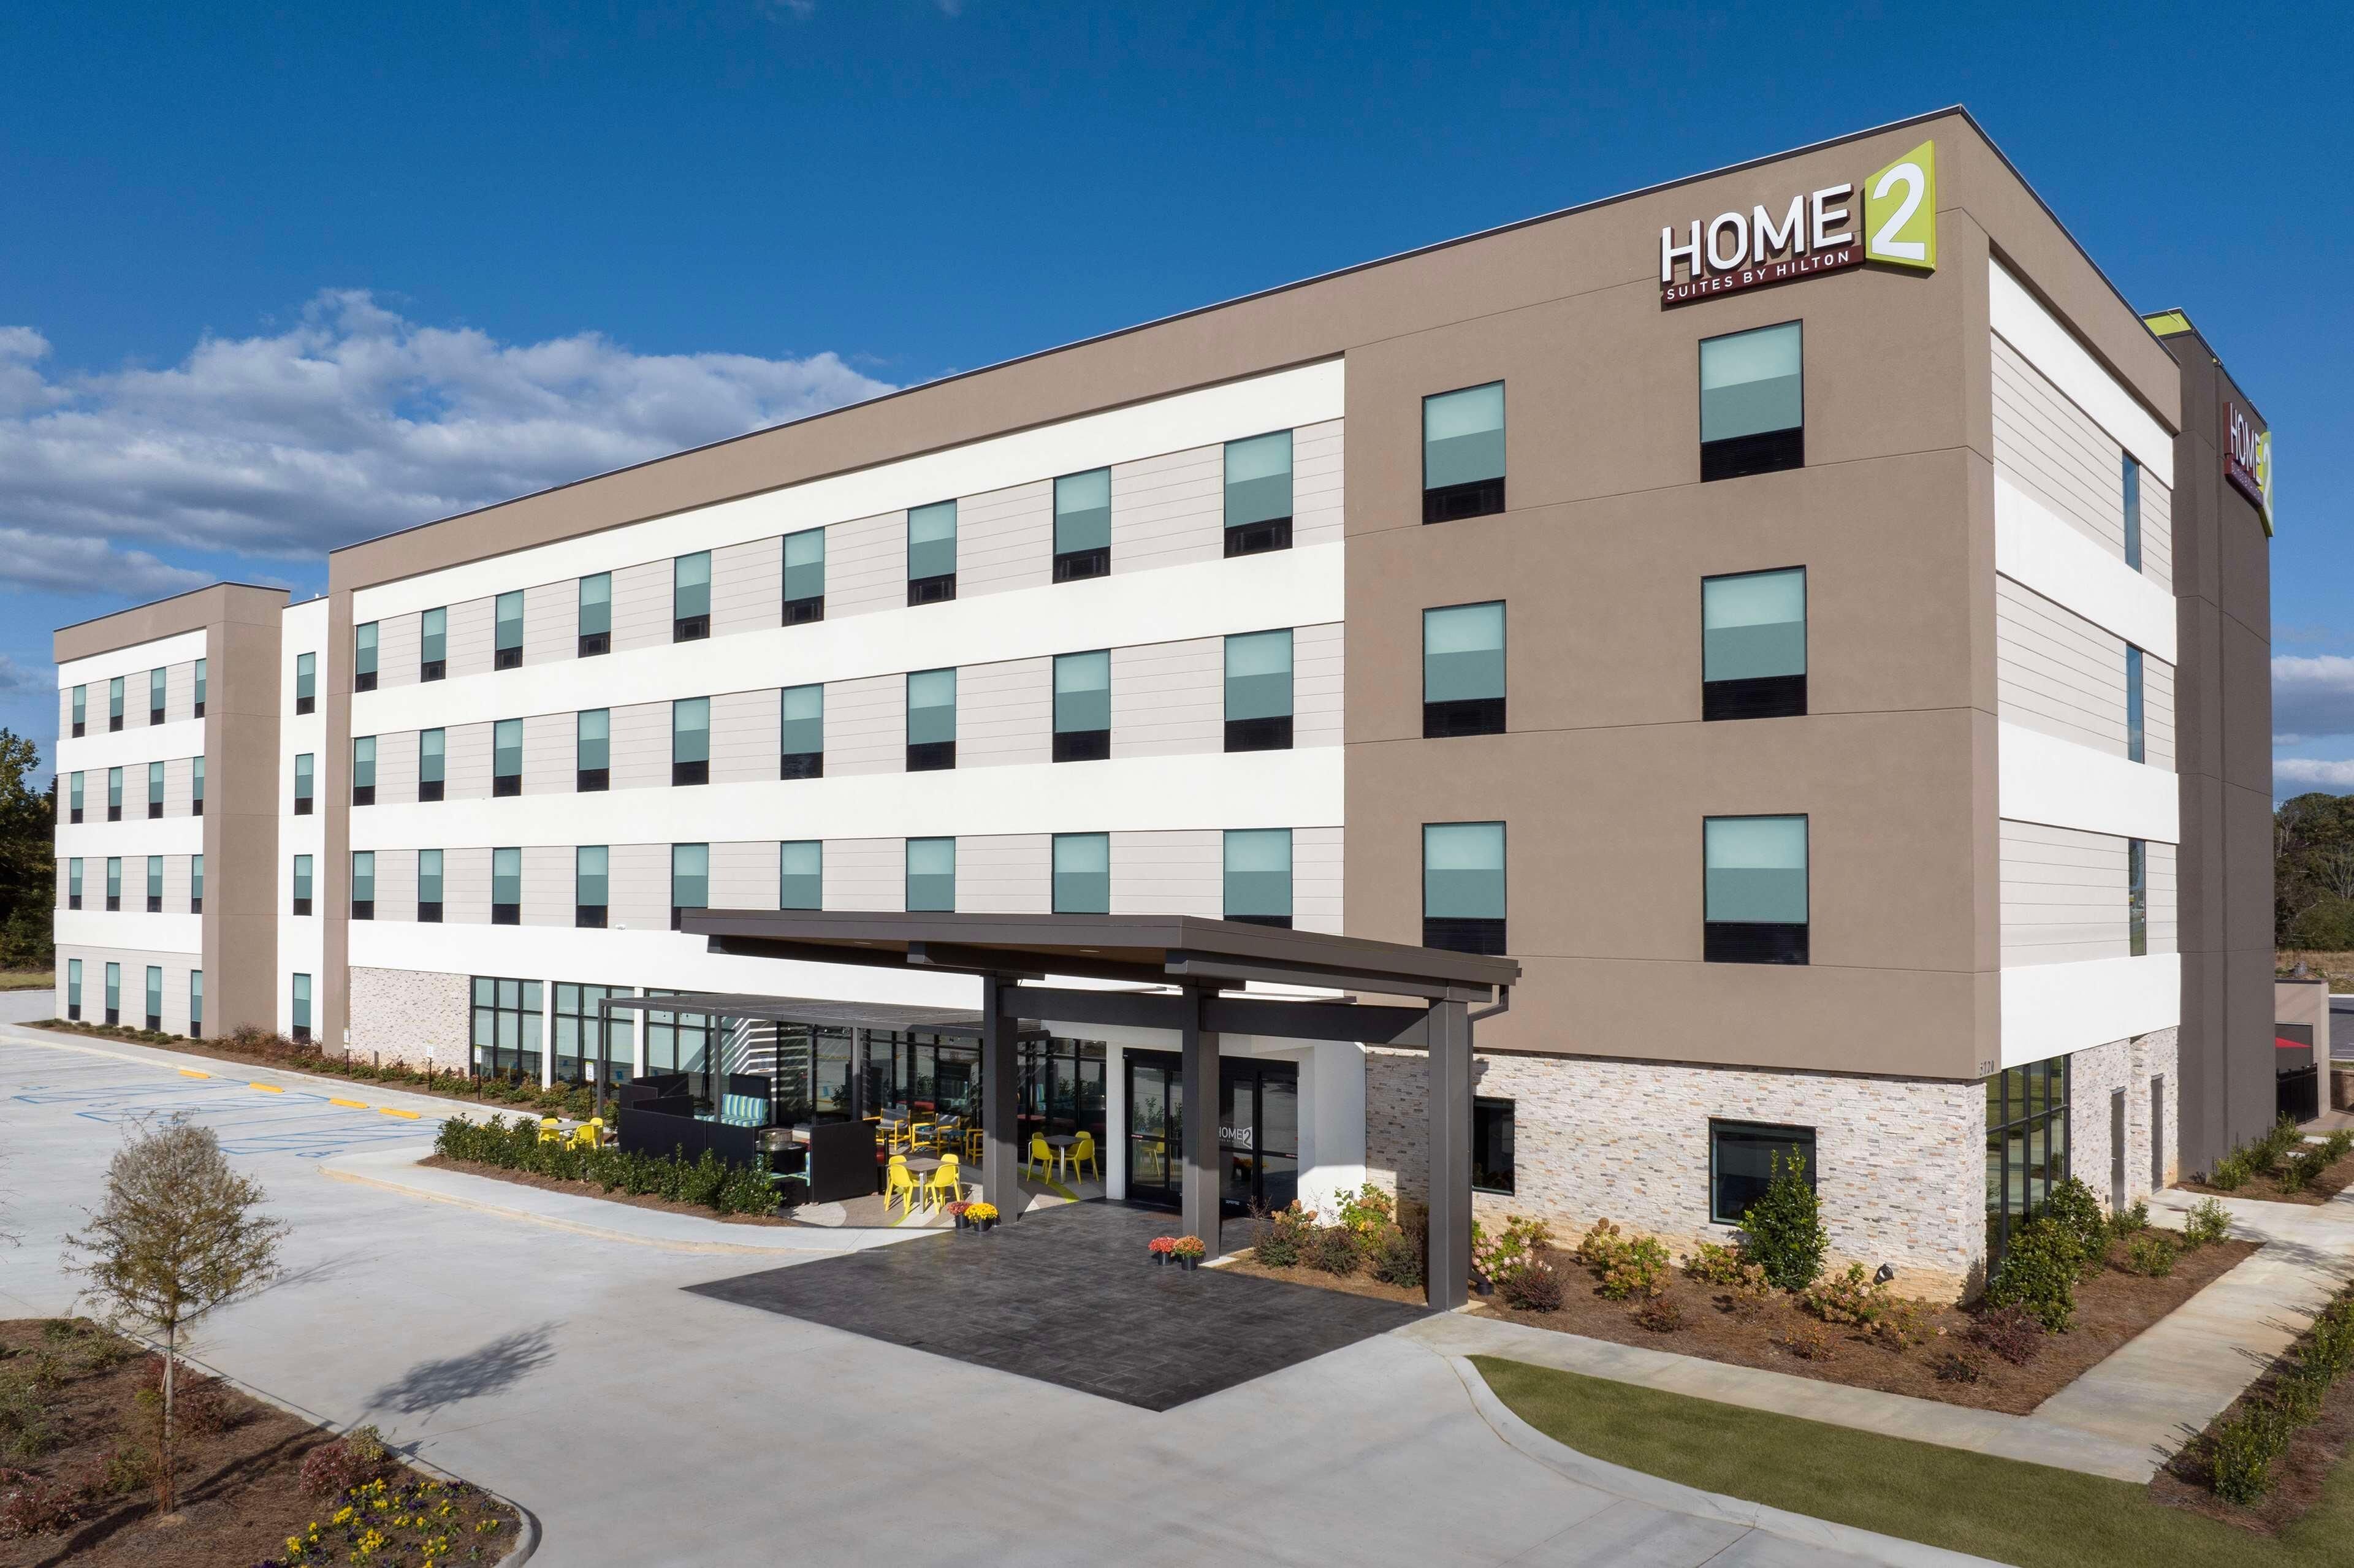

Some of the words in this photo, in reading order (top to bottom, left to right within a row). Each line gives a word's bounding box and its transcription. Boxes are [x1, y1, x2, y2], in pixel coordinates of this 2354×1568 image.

[1662, 183, 1851, 282] HOME
[1872, 162, 1925, 261] 2
[1667, 276, 1733, 300] SUITES
[1743, 268, 1767, 284] BY
[1777, 251, 1849, 276] HILTON
[2230, 403, 2261, 485] HOME
